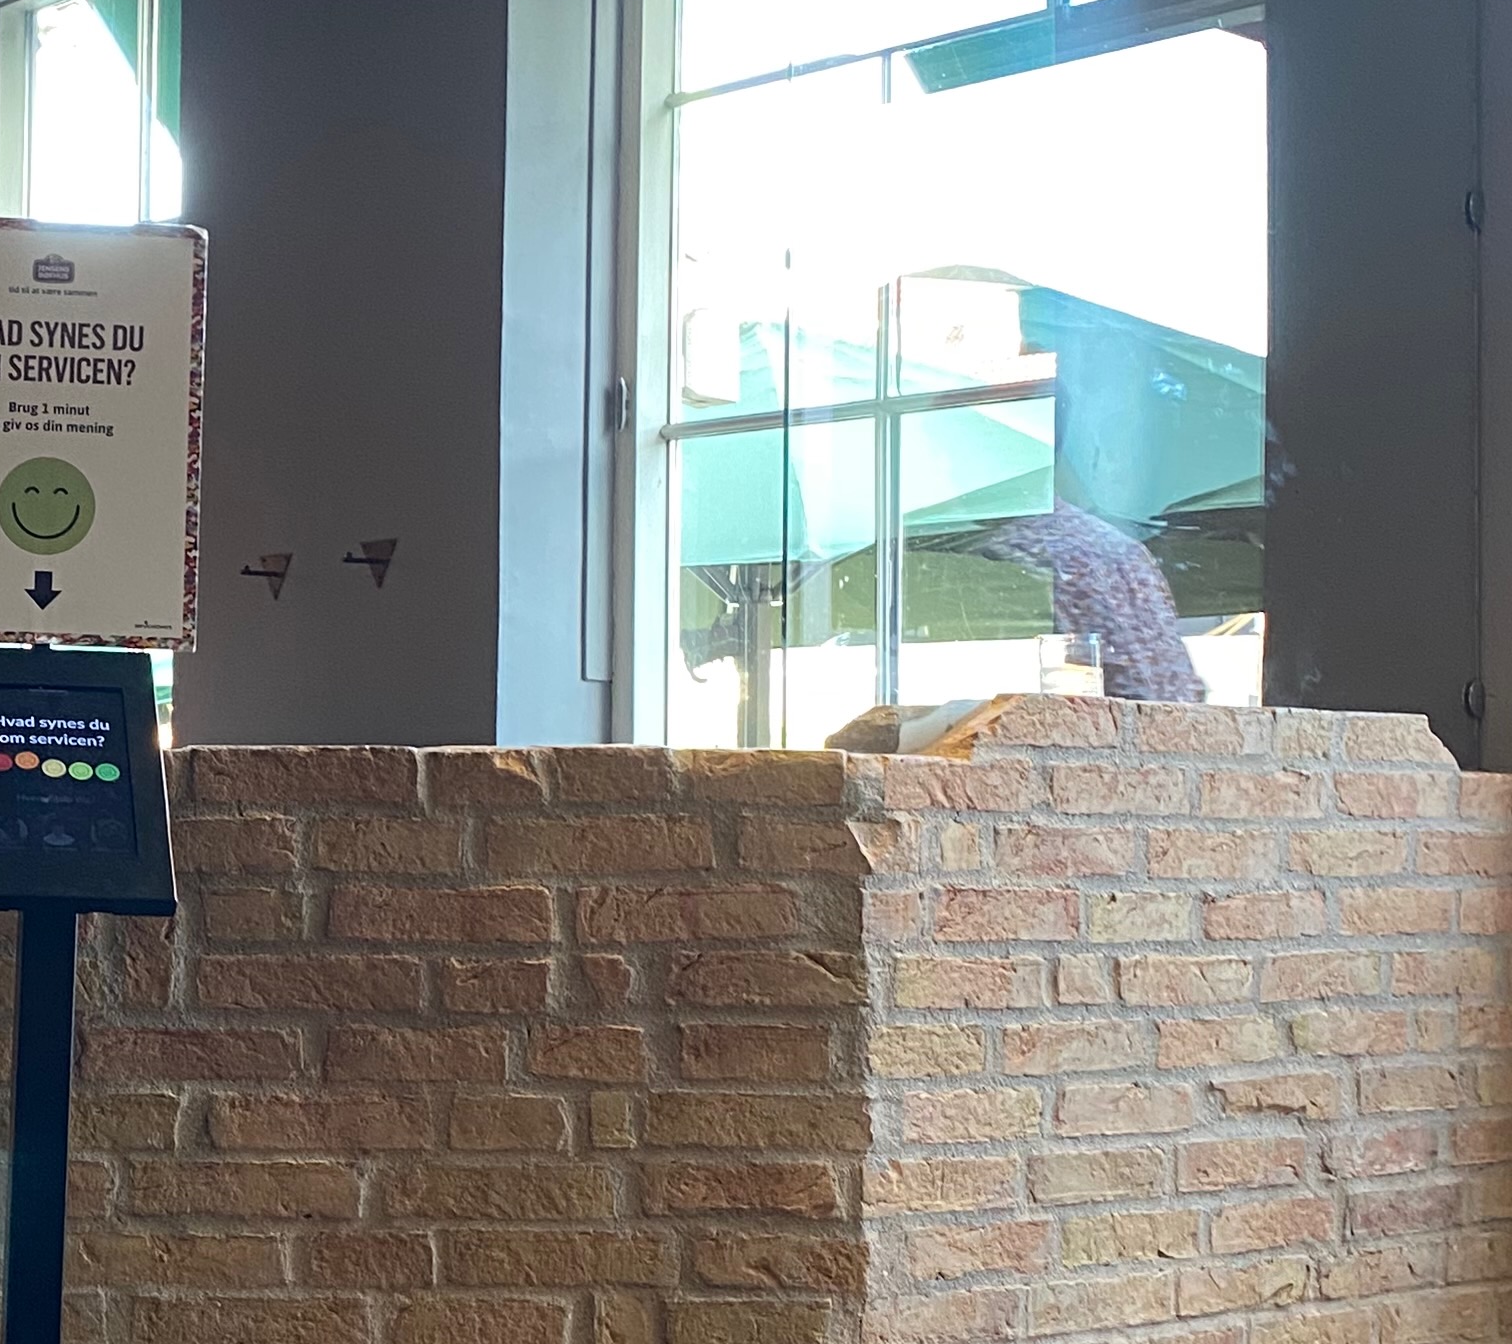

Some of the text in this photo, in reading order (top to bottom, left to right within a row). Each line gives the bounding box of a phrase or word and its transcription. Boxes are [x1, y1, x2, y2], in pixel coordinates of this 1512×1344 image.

[29, 320, 106, 350] SYNES
[112, 324, 144, 352] DU
[7, 353, 136, 386] SERVICEN?
[8, 401, 90, 416] Brug 1 minut
[3, 418, 22, 432] giv
[25, 422, 39, 431] os
[43, 420, 63, 432] din
[66, 421, 114, 437] mening
[39, 719, 86, 731] synes
[89, 719, 111, 731] du
[29, 734, 106, 747] servicen?
